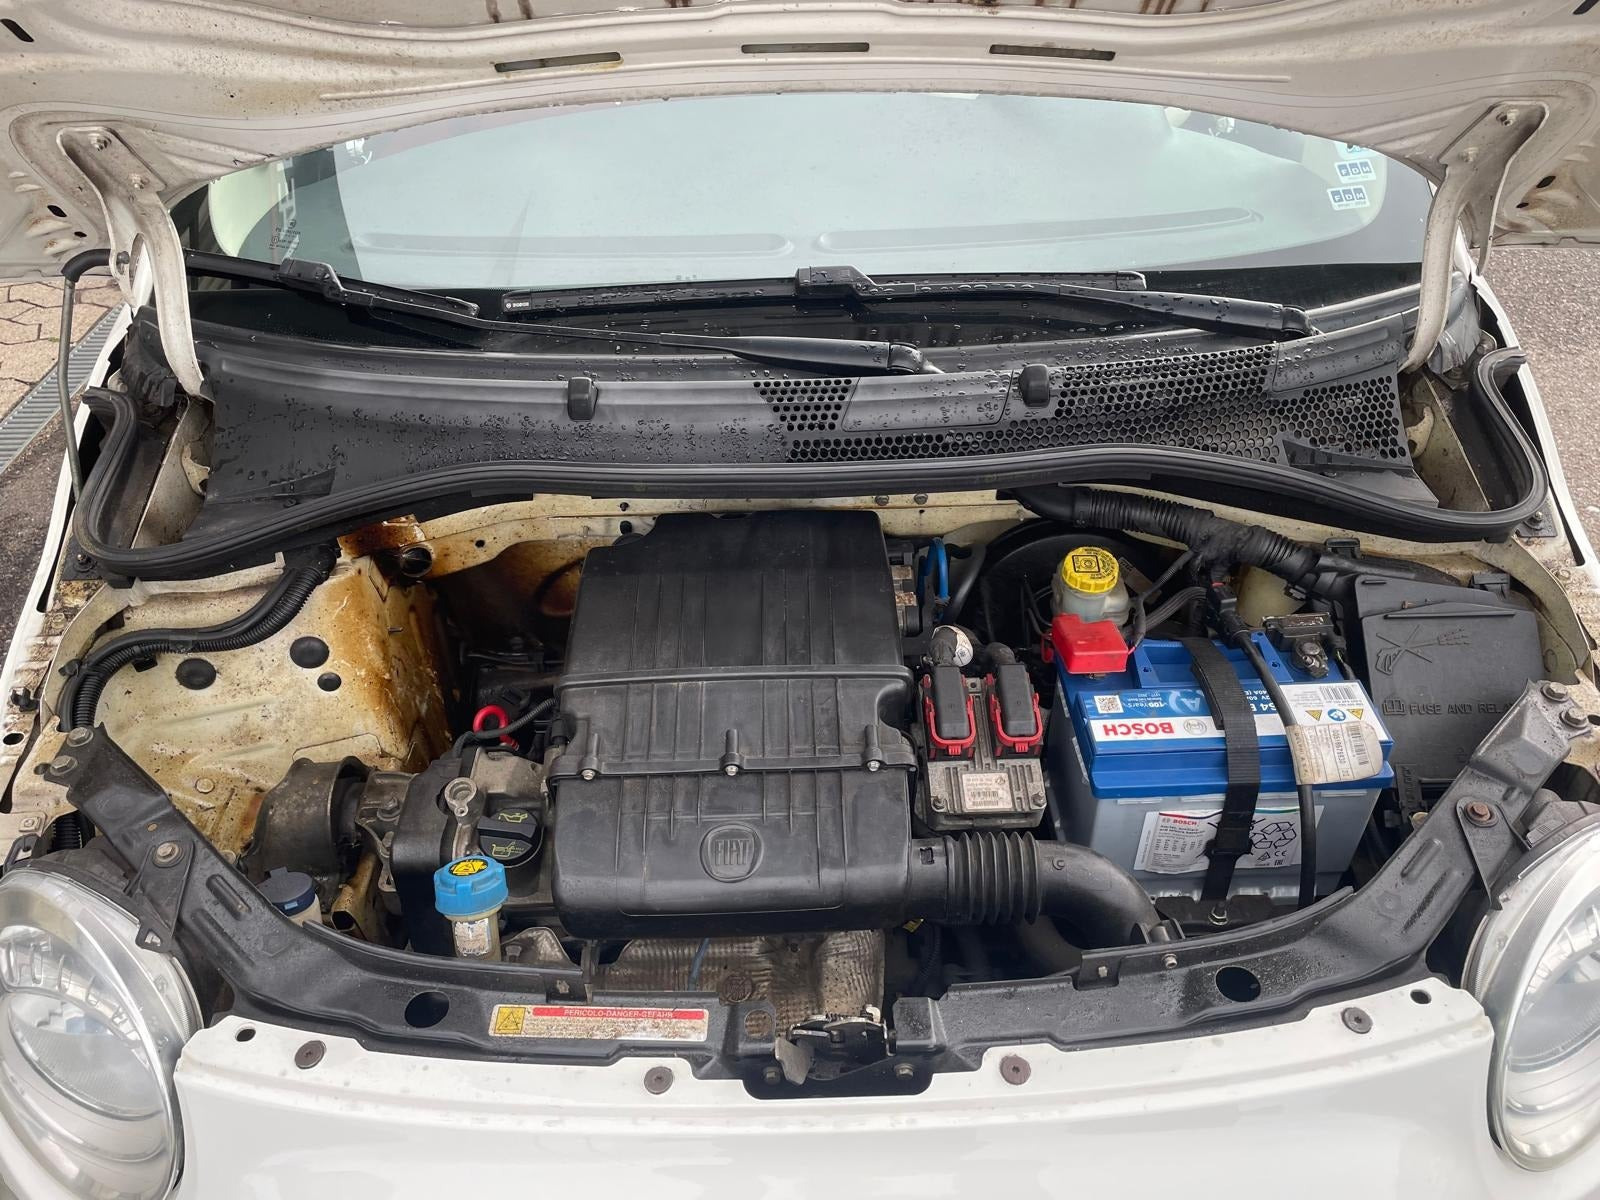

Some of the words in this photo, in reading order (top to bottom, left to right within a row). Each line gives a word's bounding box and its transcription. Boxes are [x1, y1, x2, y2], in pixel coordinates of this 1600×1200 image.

[1410, 704, 1442, 715] FUSE
[1448, 703, 1472, 714] AND
[1477, 703, 1514, 714] RELA
[1103, 722, 1174, 737] BOSCH
[714, 839, 750, 866] FIAT
